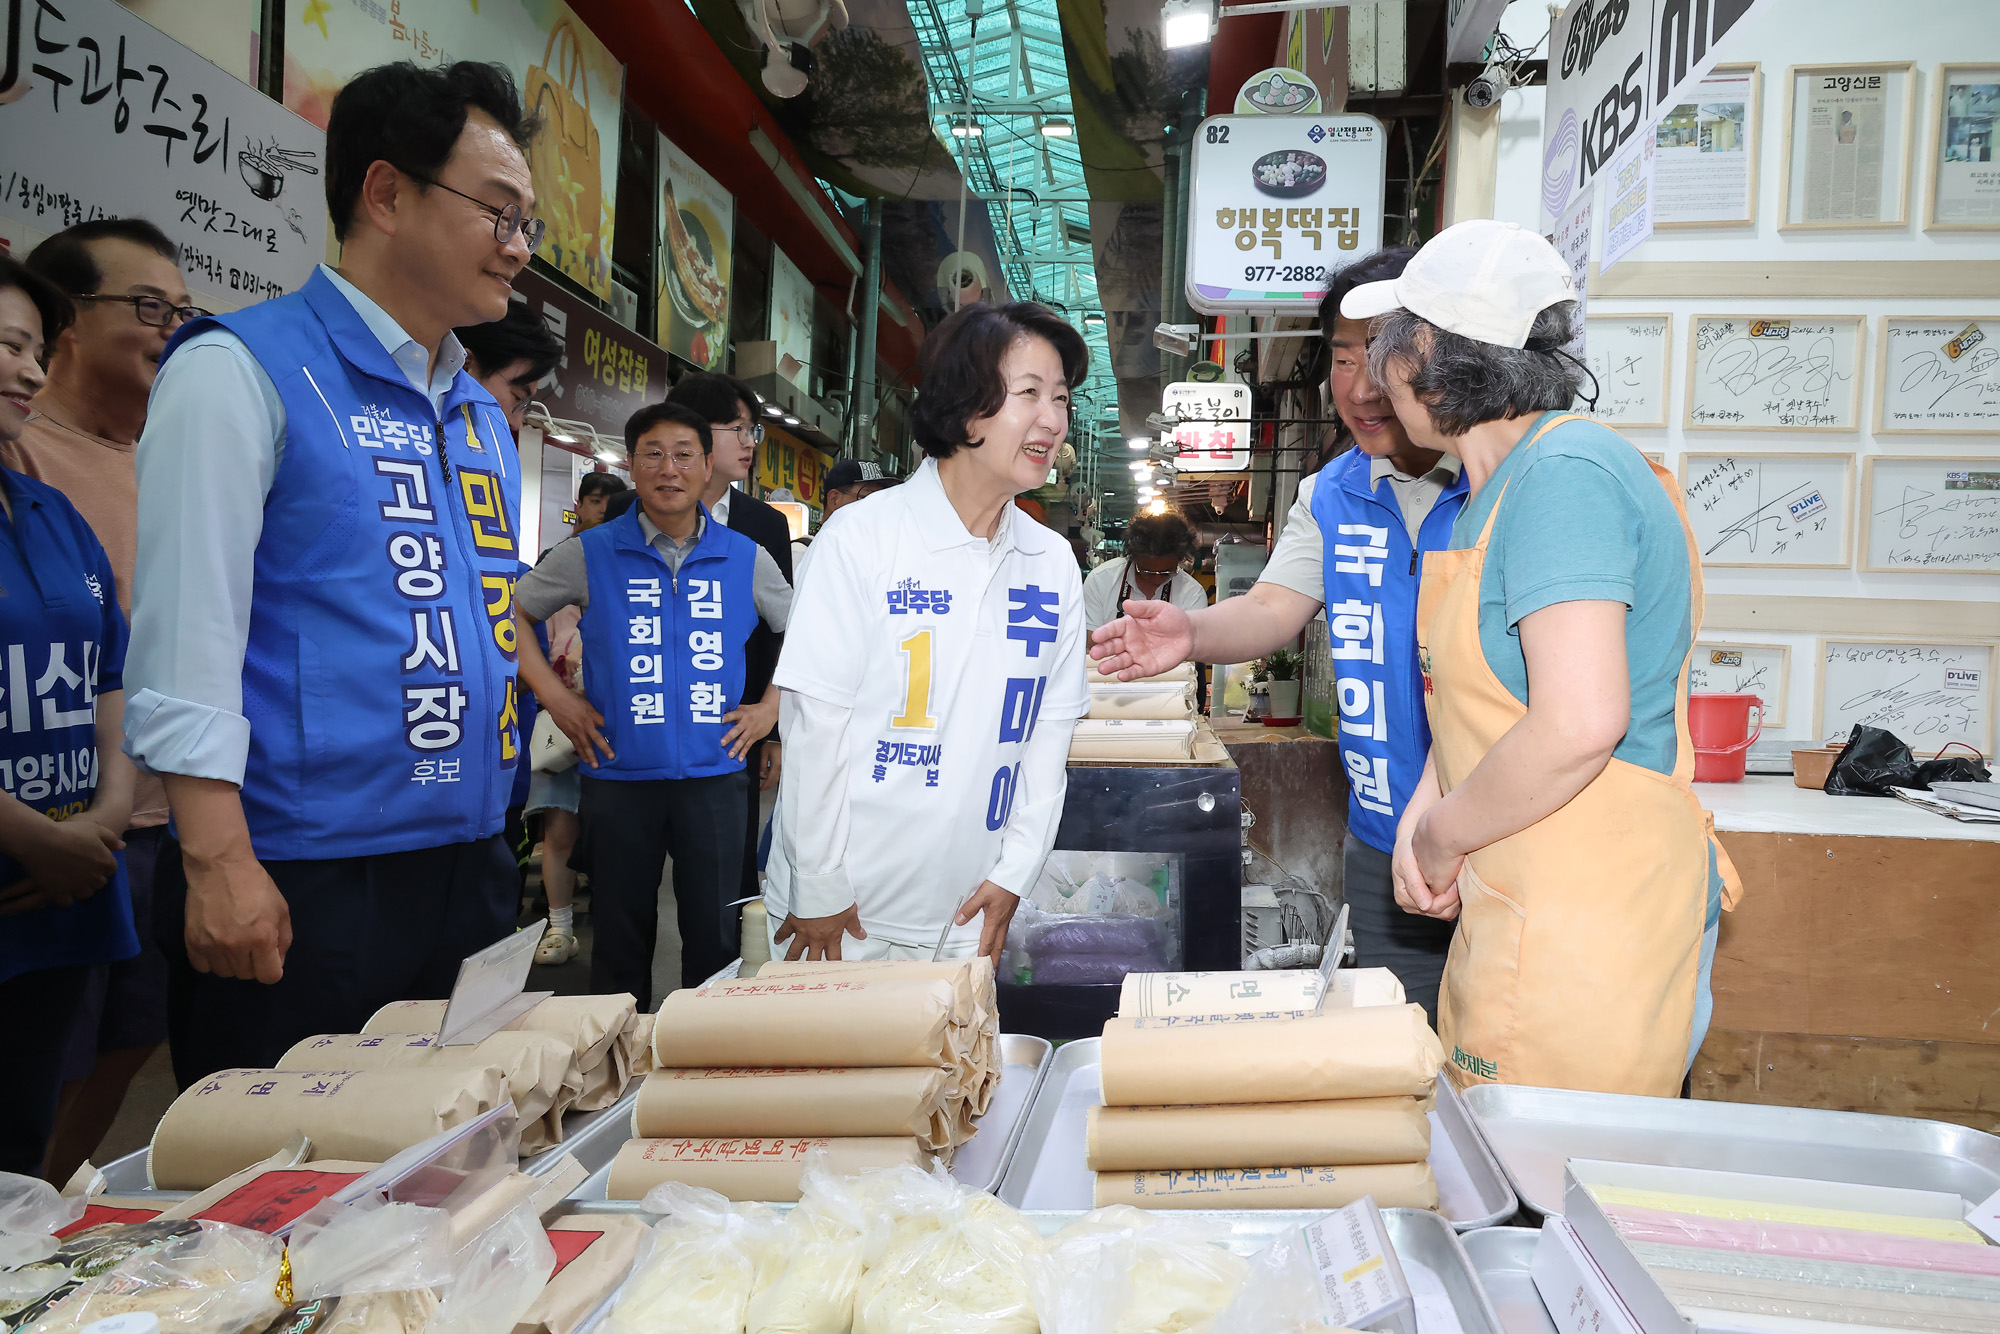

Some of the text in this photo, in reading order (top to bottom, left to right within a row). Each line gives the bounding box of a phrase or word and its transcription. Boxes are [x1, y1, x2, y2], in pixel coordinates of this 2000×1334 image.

[1823, 76, 1881, 92] 고양신문
[1206, 125, 1230, 144] 82
[1580, 51, 1643, 188] KBS
[1216, 207, 1360, 260] 행복떡집
[1244, 266, 1326, 282] 977-2882
[584, 328, 648, 402] 여성잡화
[1234, 390, 1243, 398] 81
[350, 415, 433, 456] 민주당
[1176, 430, 1236, 460] 반찬
[377, 460, 466, 749] 고양시장
[886, 589, 953, 615] 민주당
[627, 578, 666, 725] 국회의원
[687, 578, 727, 724] 김영환
[1331, 523, 1394, 817] 국회의원
[890, 629, 939, 731] 1
[411, 758, 460, 786] 후보
[875, 739, 942, 767] 경기도지사
